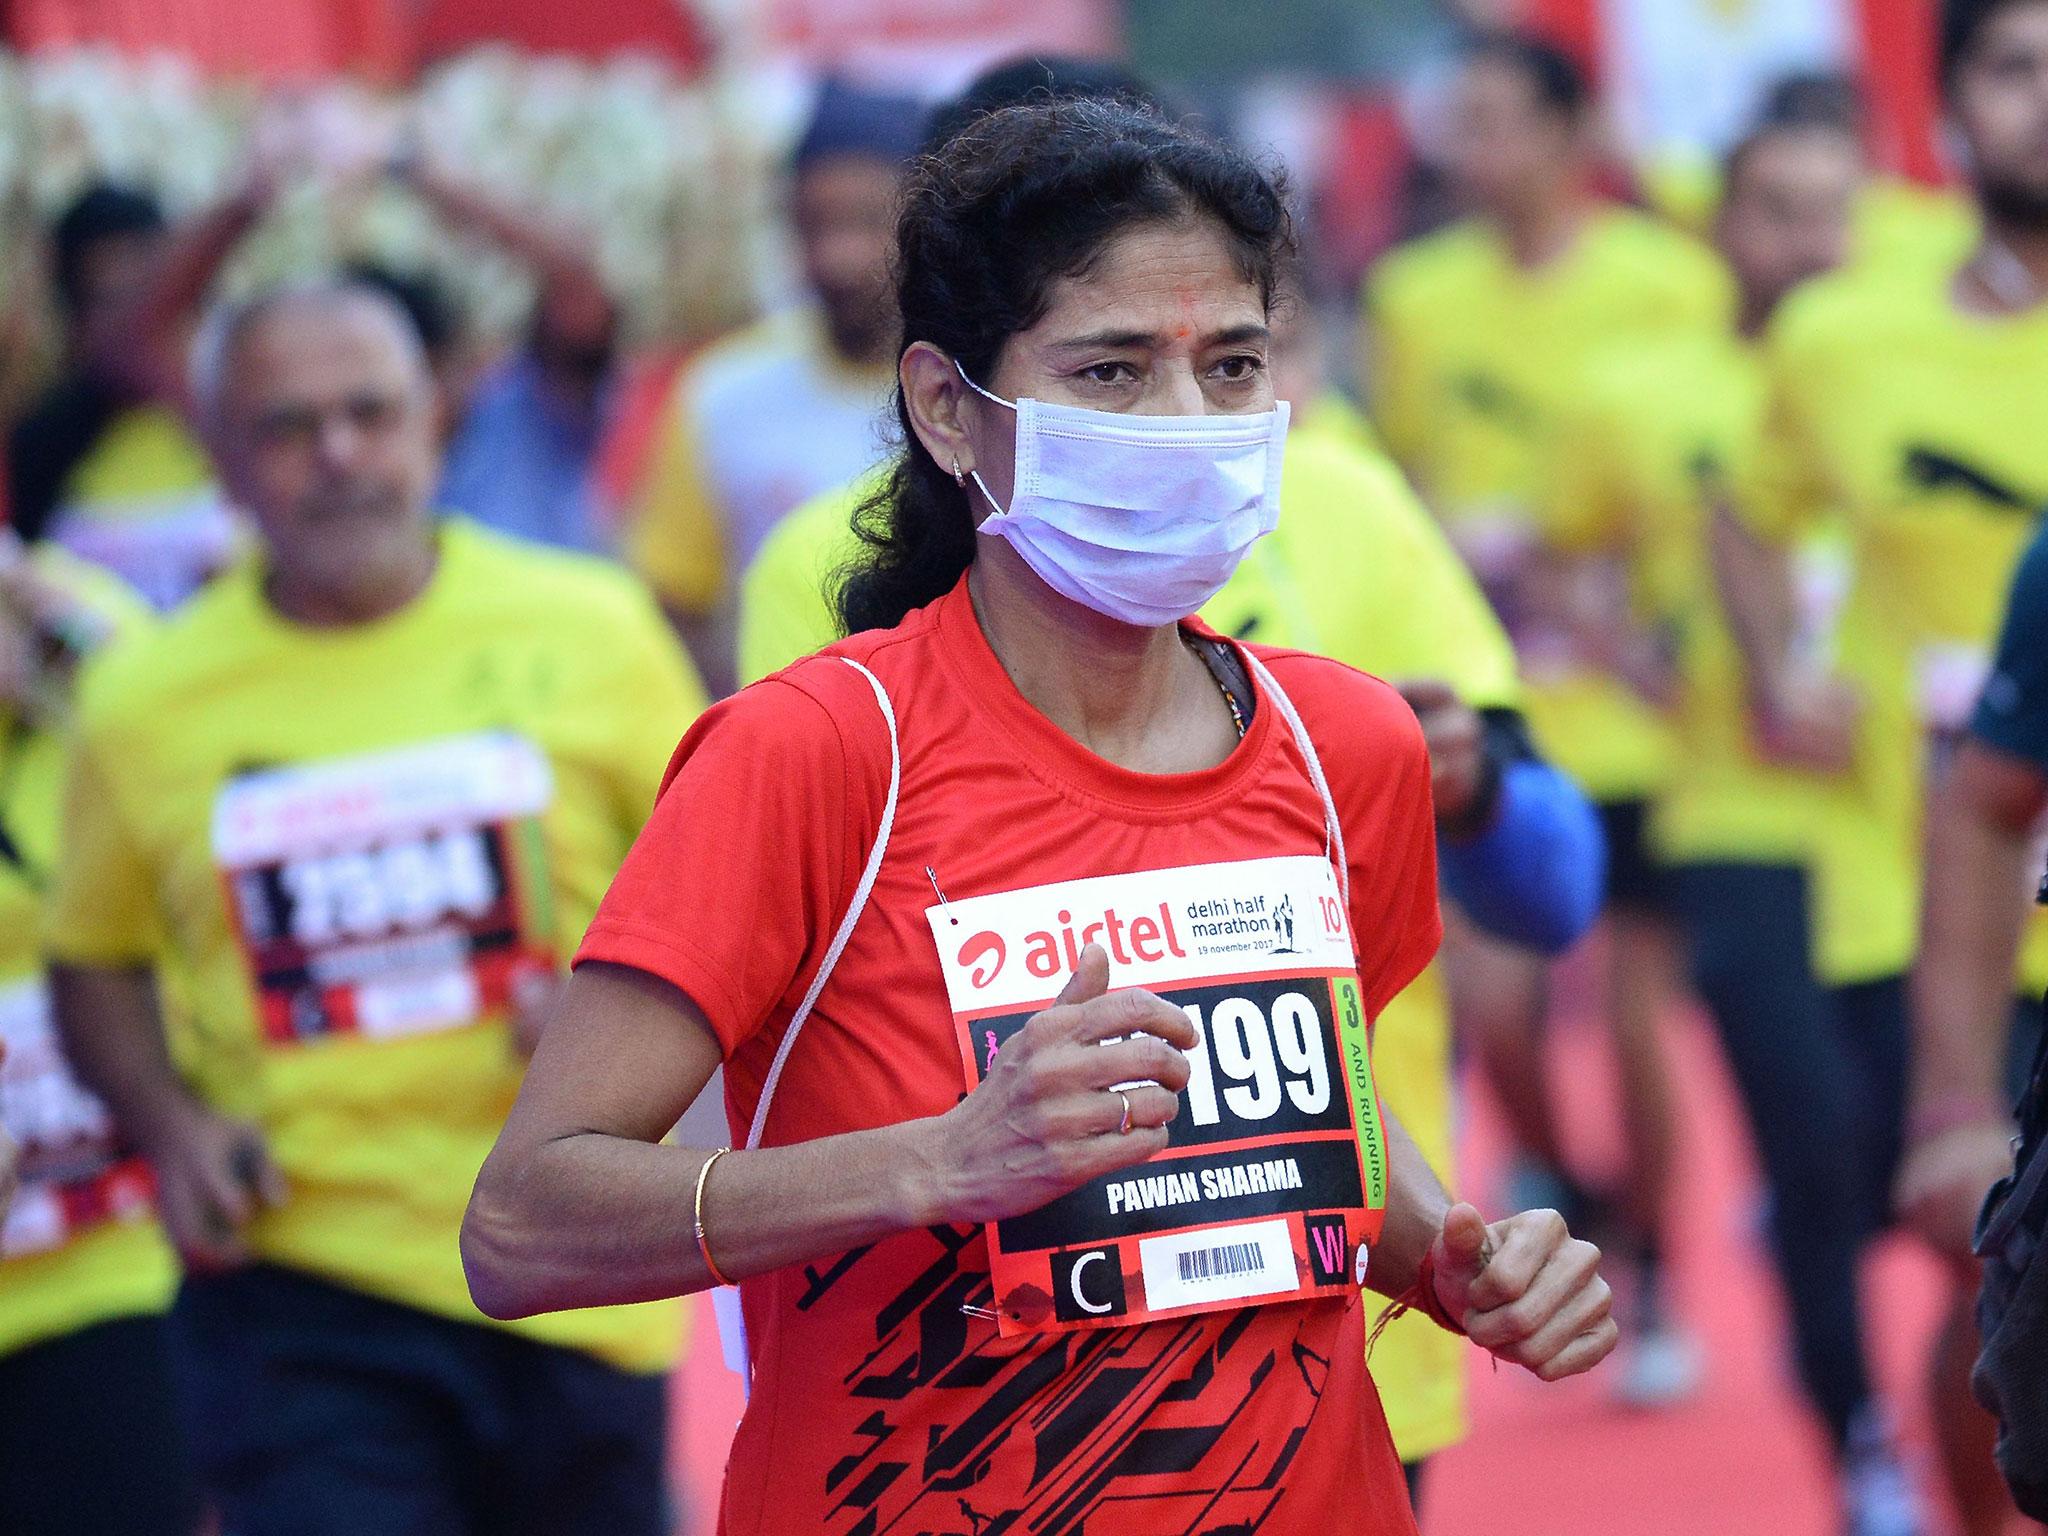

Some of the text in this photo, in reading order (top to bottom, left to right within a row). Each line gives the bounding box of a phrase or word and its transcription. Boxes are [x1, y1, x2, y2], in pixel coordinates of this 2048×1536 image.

[1187, 895, 1265, 919] delhi half
[1192, 917, 1270, 938] marathon
[1318, 896, 1341, 934] 10
[1024, 902, 1186, 978] airtel
[1198, 939, 1273, 955] 19 november 2017
[1342, 983, 1382, 1198] 3 AND RUNNING
[1106, 1158, 1303, 1215] PAWAN SHARMA
[1311, 1225, 1344, 1274] W
[1070, 1251, 1112, 1314] C
